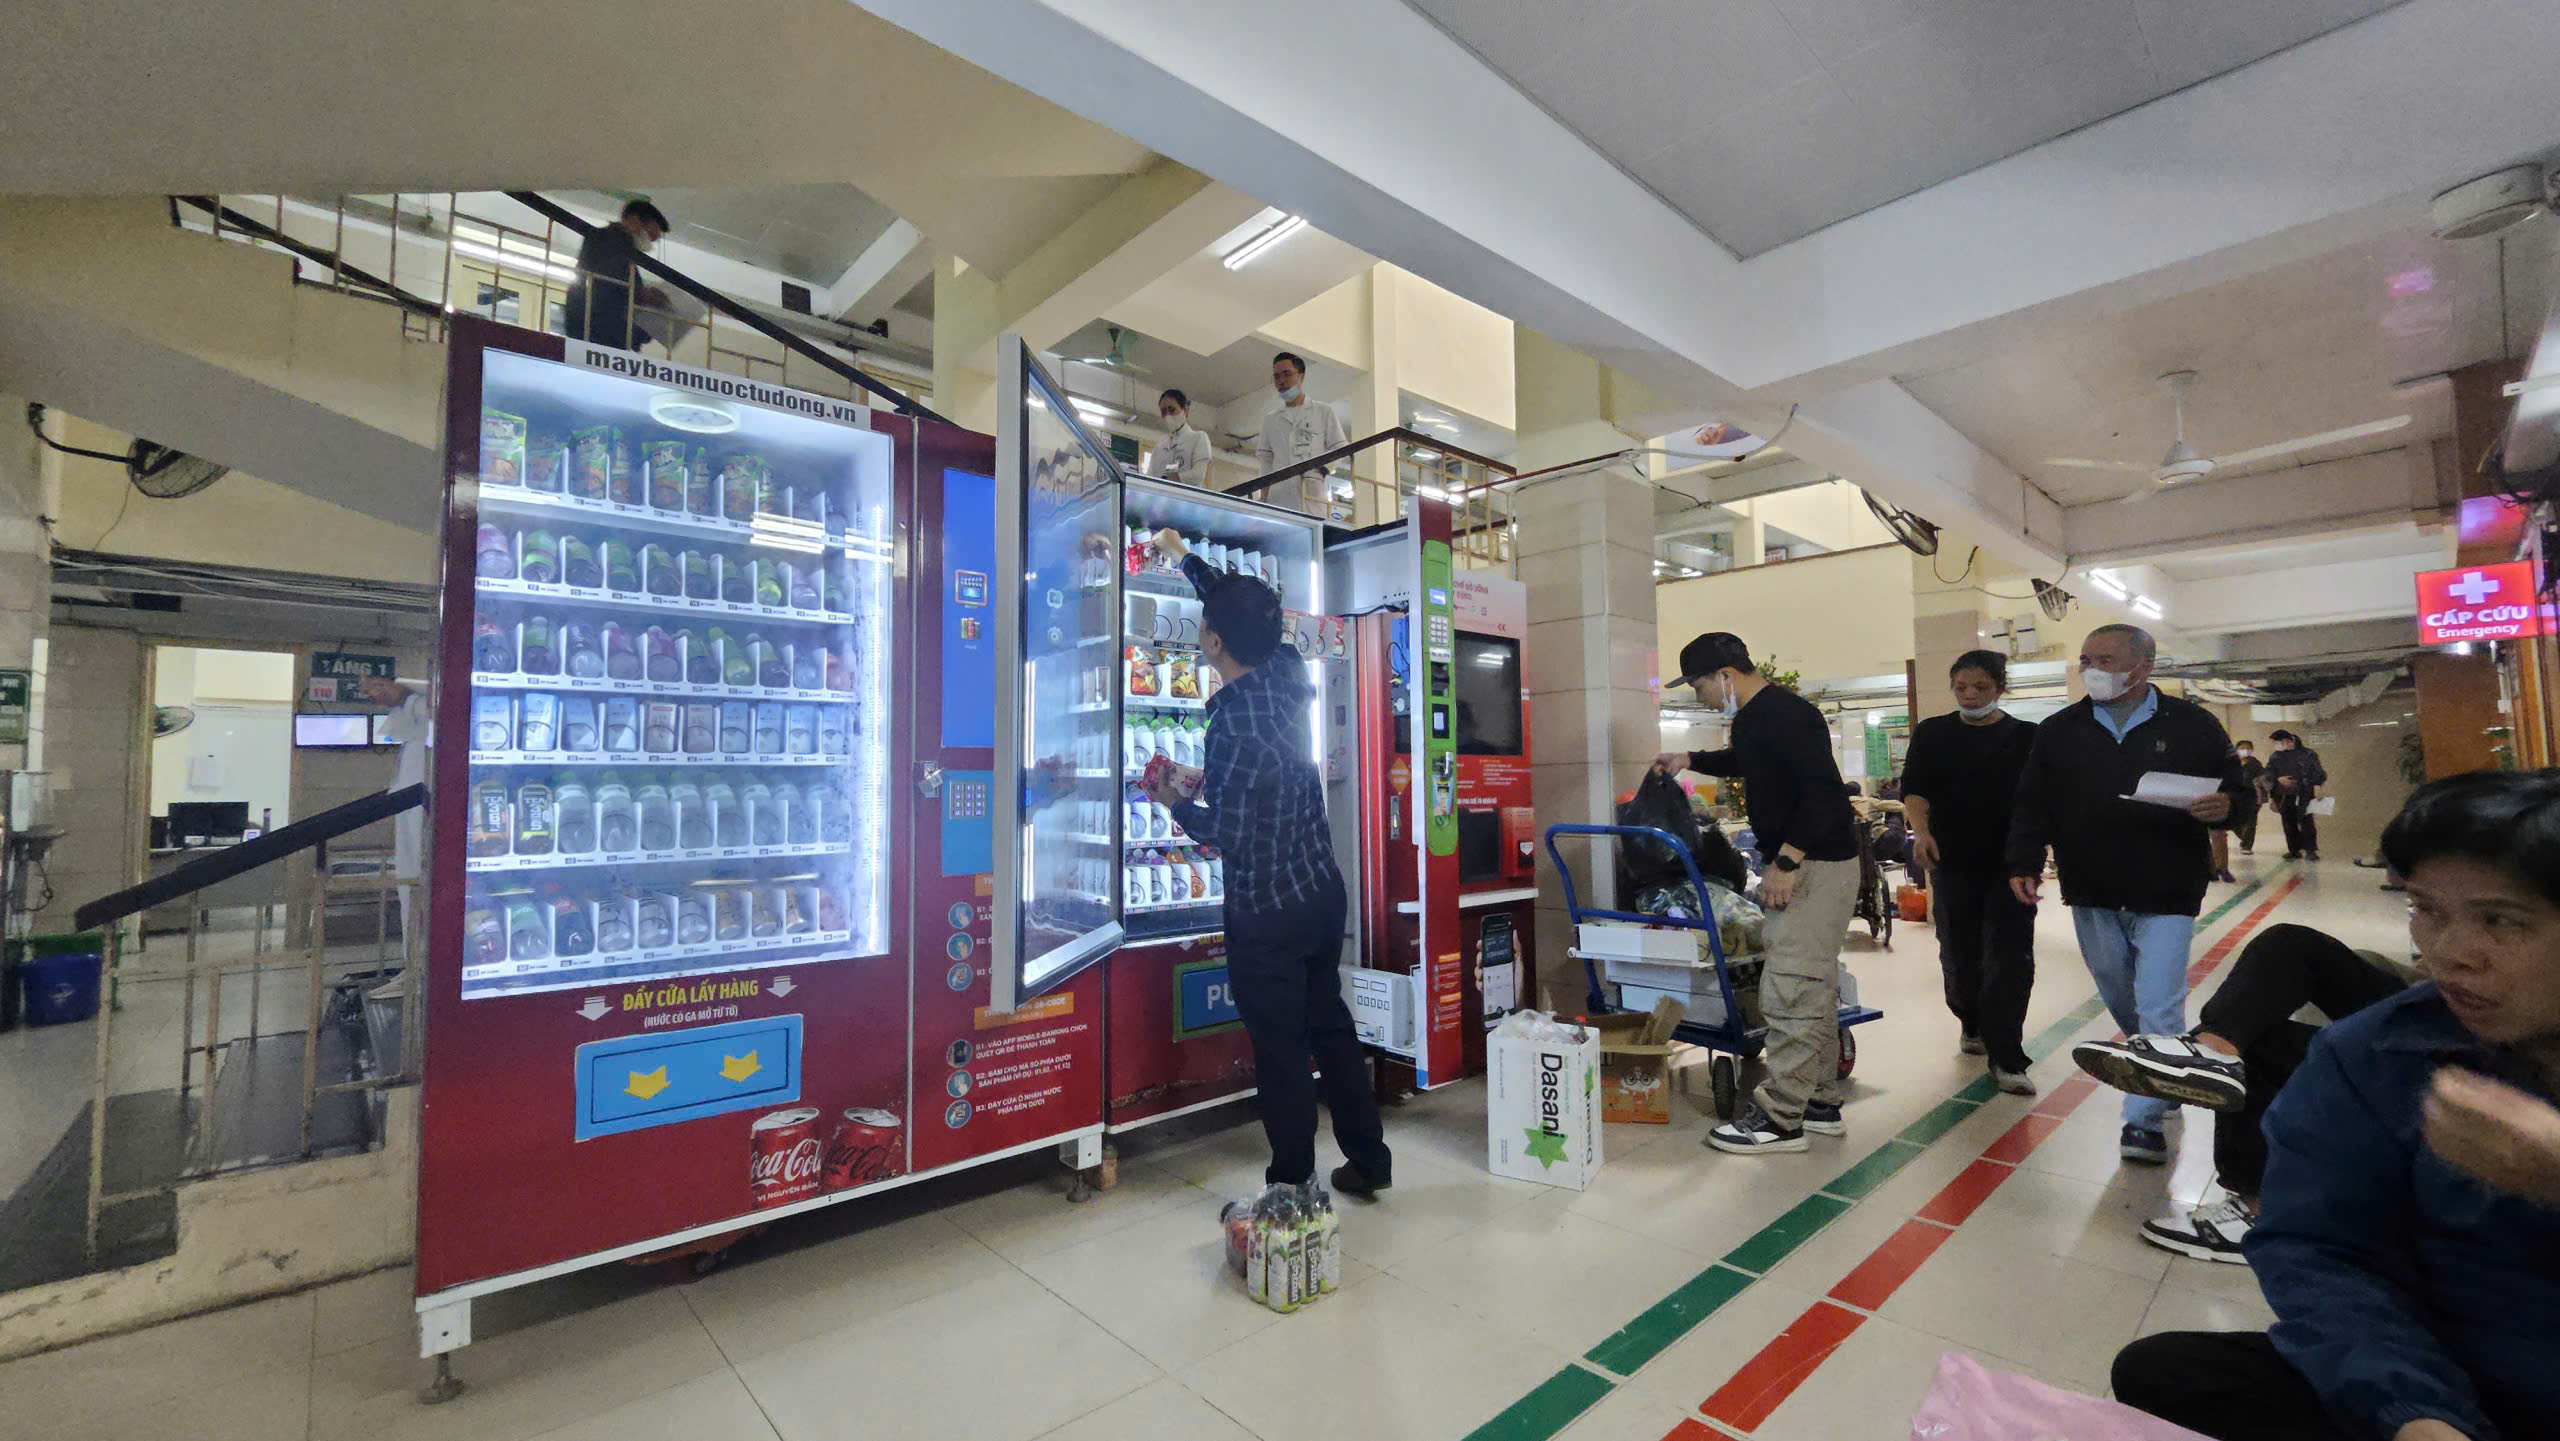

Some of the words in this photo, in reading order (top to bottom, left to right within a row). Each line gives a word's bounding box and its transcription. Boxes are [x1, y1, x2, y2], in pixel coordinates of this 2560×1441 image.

[585, 348, 857, 422] maybannuoctudong.vn
[2477, 605, 2529, 623] CỨU
[2437, 624, 2520, 638] Emergency
[623, 985, 655, 1011] ĐẨY
[656, 983, 687, 1007] CỬA
[690, 978, 717, 1003] LẤY
[720, 978, 759, 999] HÀNG
[1207, 983, 1236, 1010] PU
[672, 1011, 684, 1023] CÓ
[685, 1011, 697, 1022] GA
[1002, 1037, 1017, 1046] APP
[1016, 1041, 1038, 1052] THANH
[1540, 1052, 1565, 1139] Dasani
[767, 1186, 801, 1198] NGUYÊN
